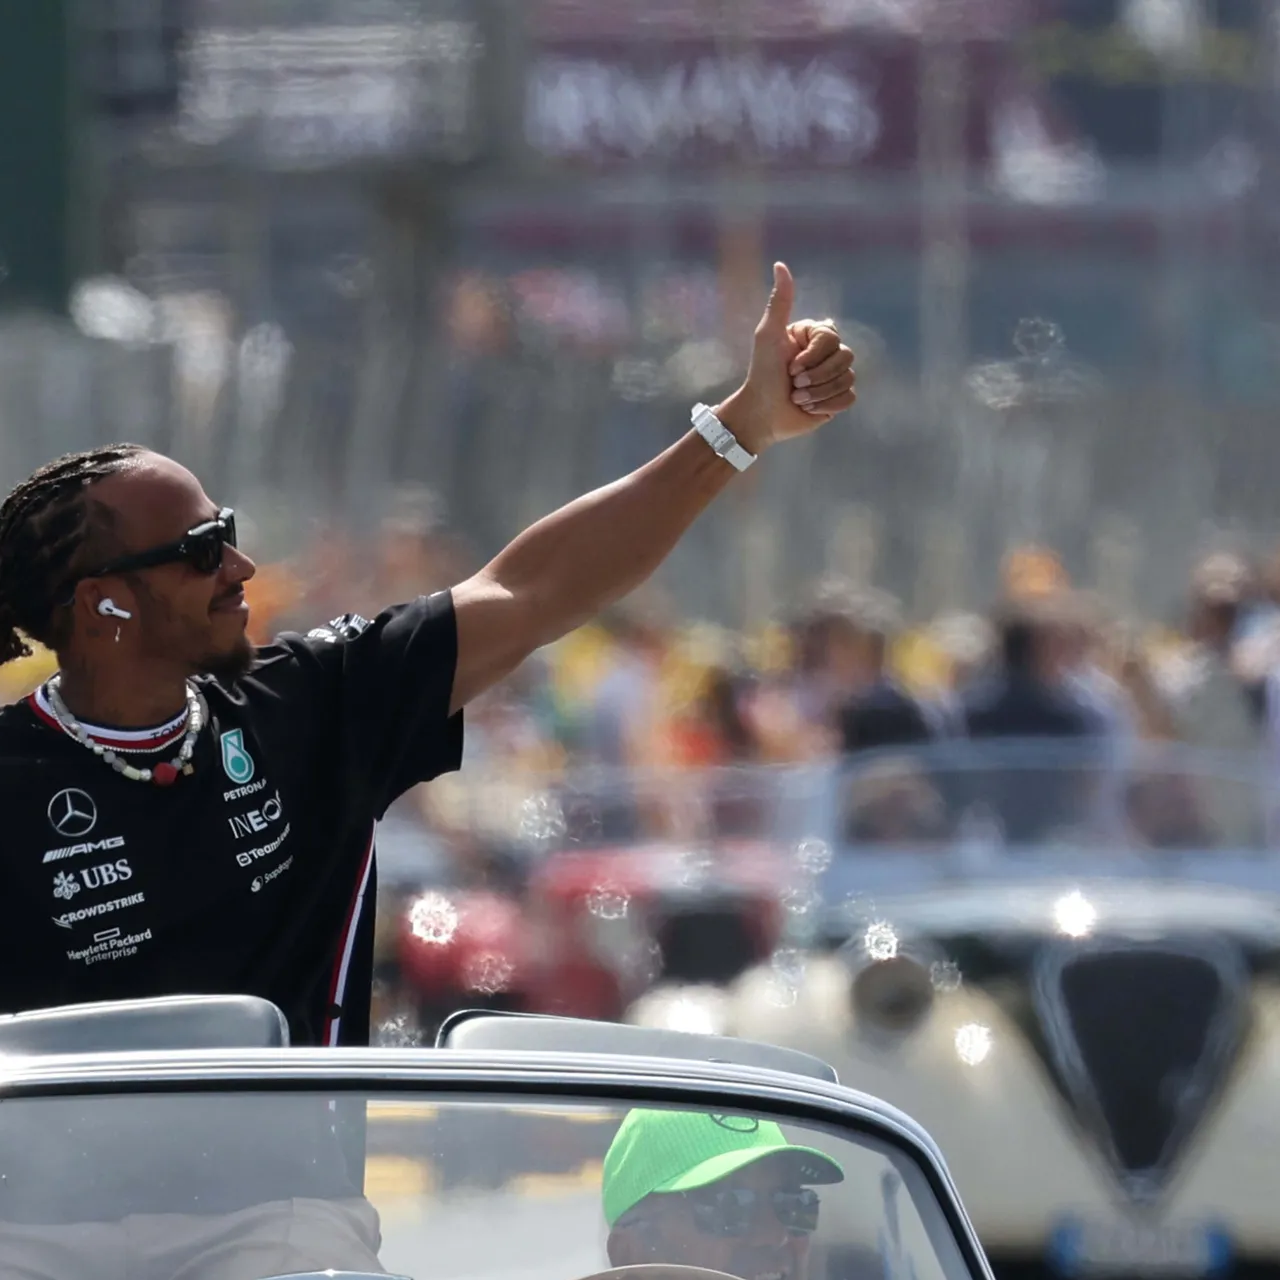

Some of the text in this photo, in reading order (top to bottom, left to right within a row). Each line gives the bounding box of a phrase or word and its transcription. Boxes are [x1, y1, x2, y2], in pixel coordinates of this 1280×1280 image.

[80, 859, 132, 889] UBS
[60, 892, 145, 925] CROWDSTRIKE
[66, 928, 152, 961] Hewlett Packard
[85, 946, 138, 966] Enterprise
